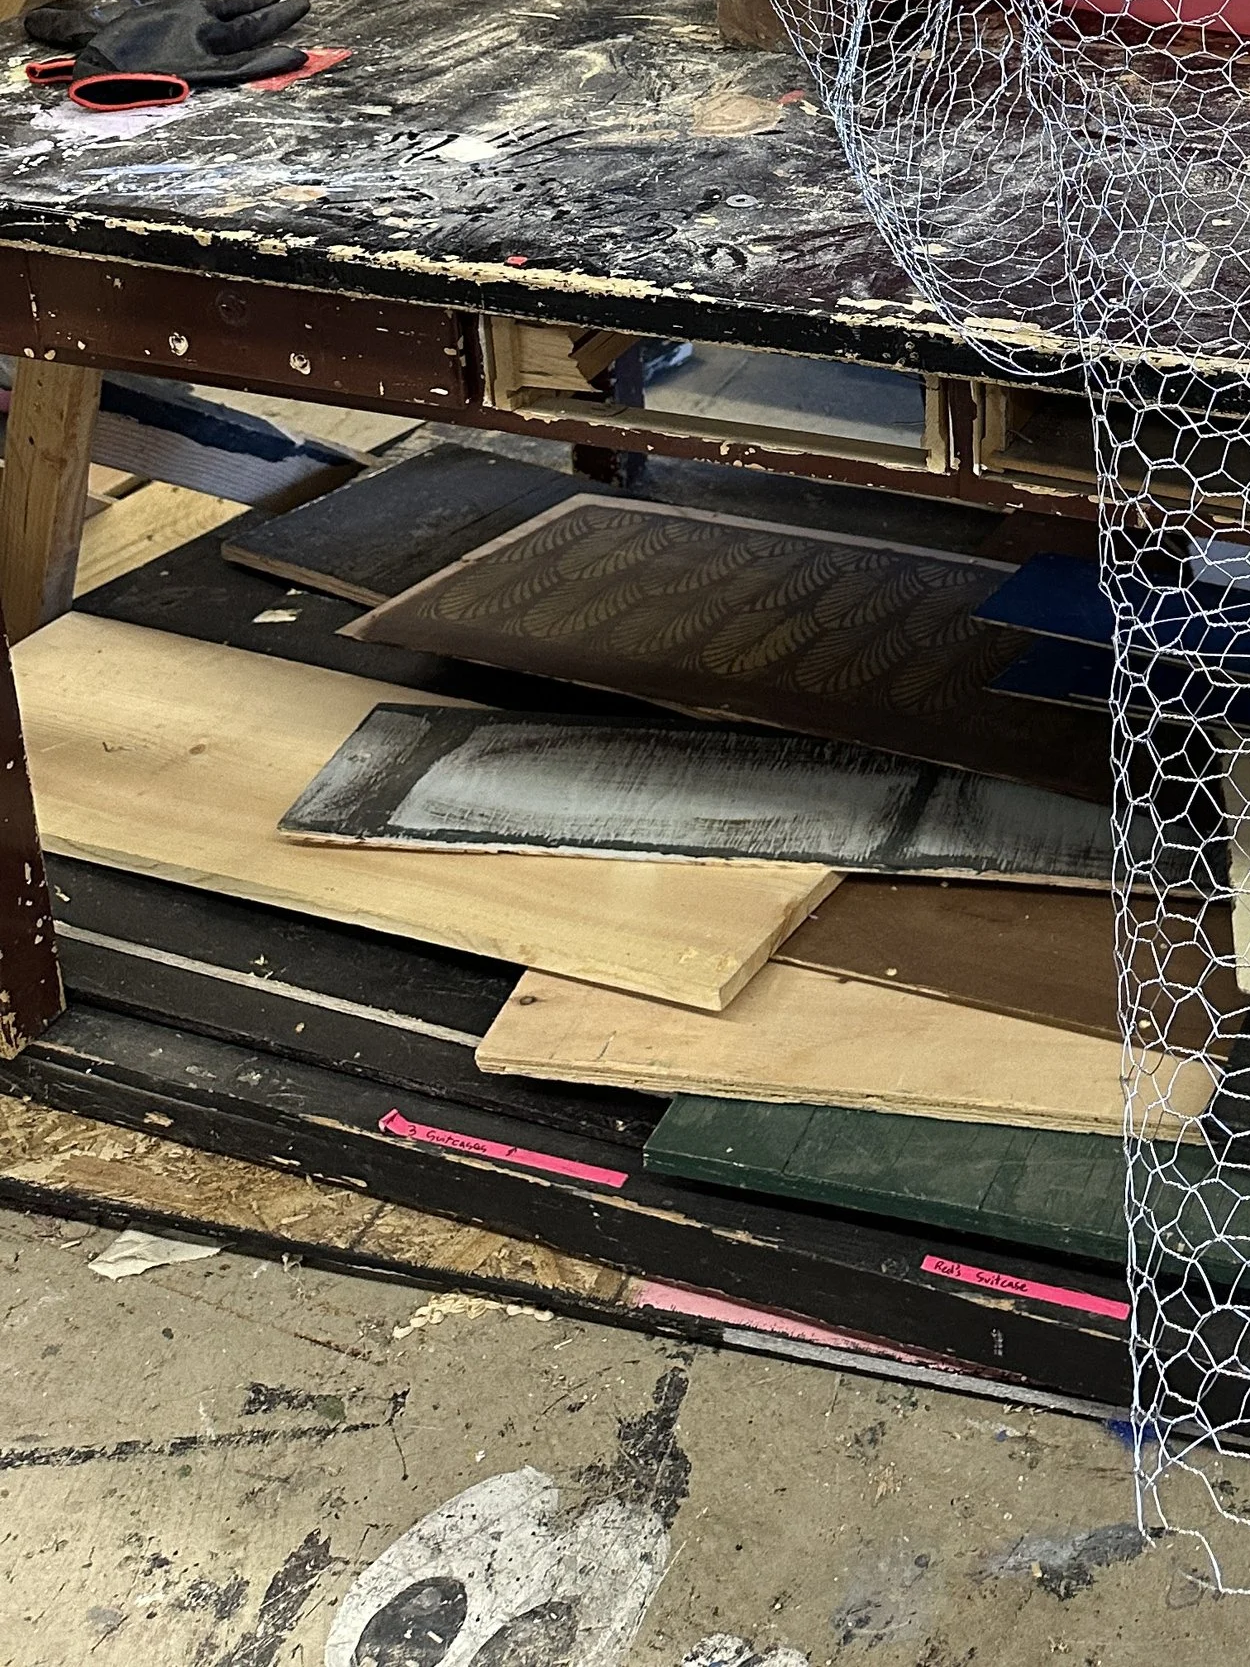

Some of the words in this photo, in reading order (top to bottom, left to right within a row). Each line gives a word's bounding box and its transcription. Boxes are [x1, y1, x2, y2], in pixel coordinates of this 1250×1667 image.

[407, 1125, 417, 1137] 3
[934, 1261, 962, 1277] Red's
[975, 1271, 1029, 1292] Suitcase
